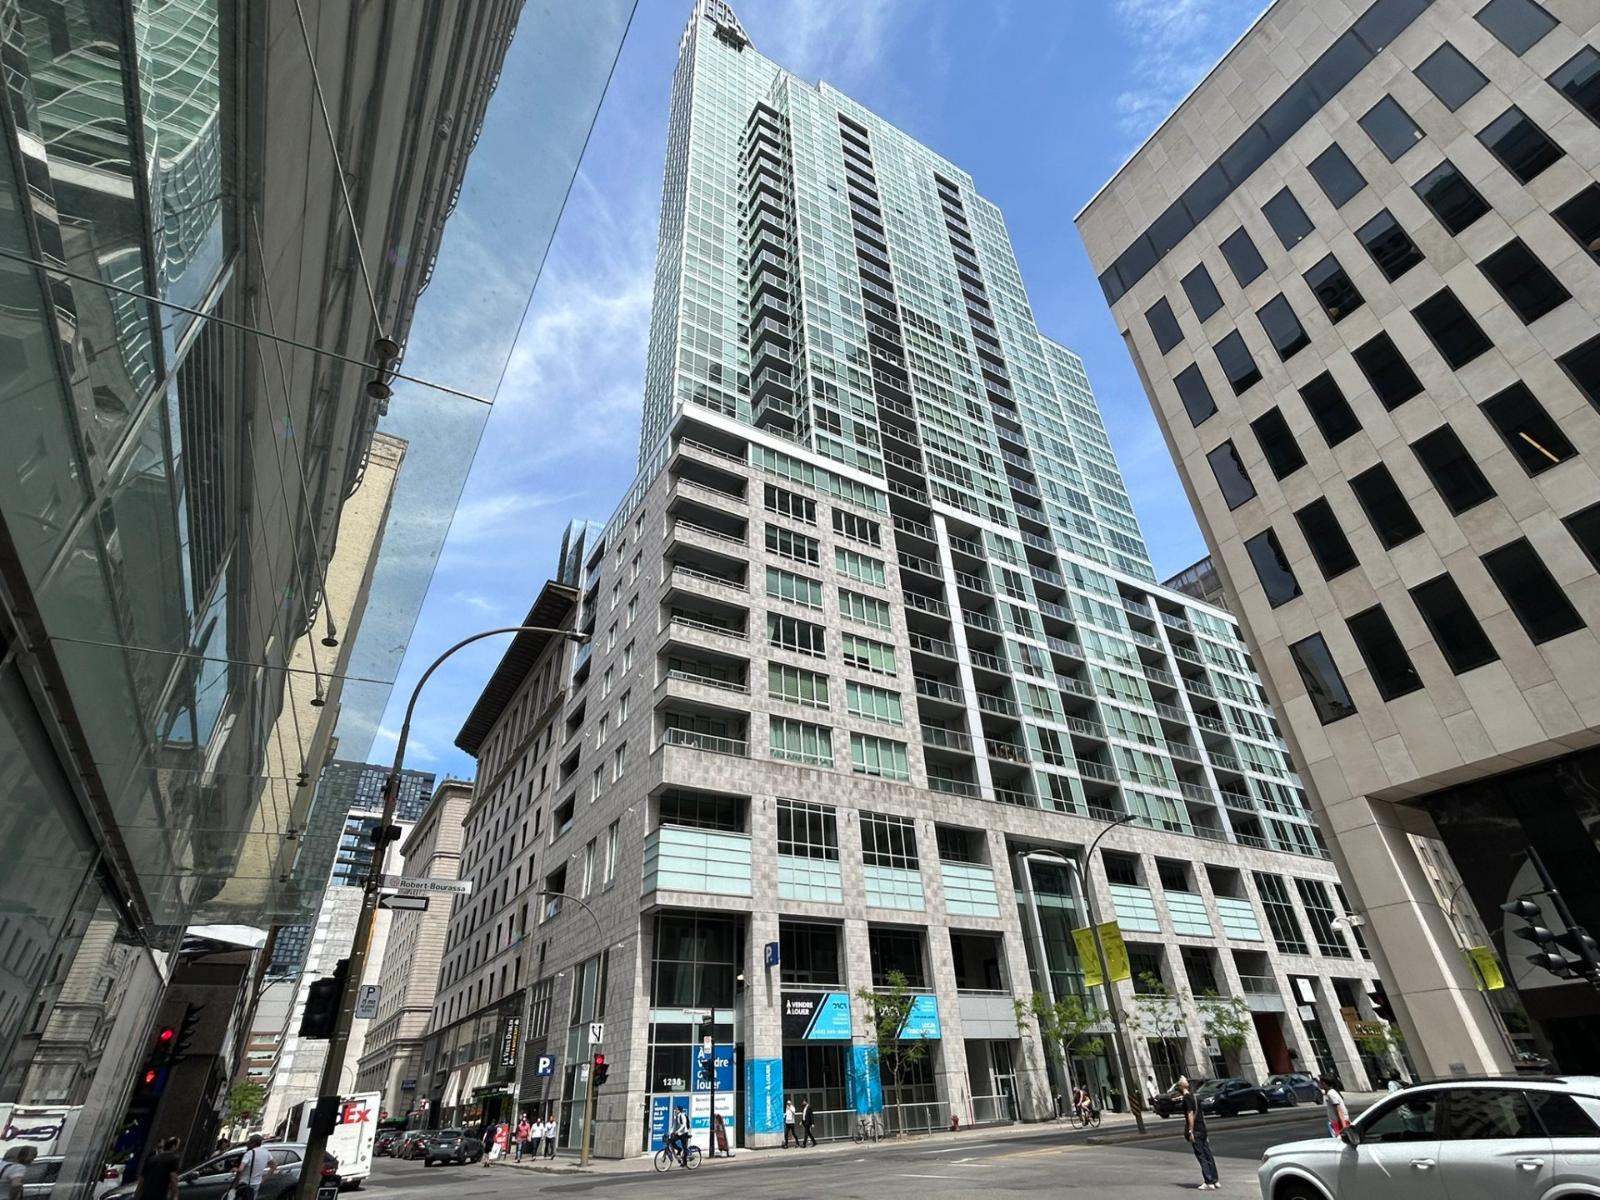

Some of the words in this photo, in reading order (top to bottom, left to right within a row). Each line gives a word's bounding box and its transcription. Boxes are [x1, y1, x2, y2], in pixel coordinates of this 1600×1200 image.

[400, 880, 466, 892] Robert-Bourassa
[366, 986, 376, 999] P
[538, 1057, 551, 1074] P
